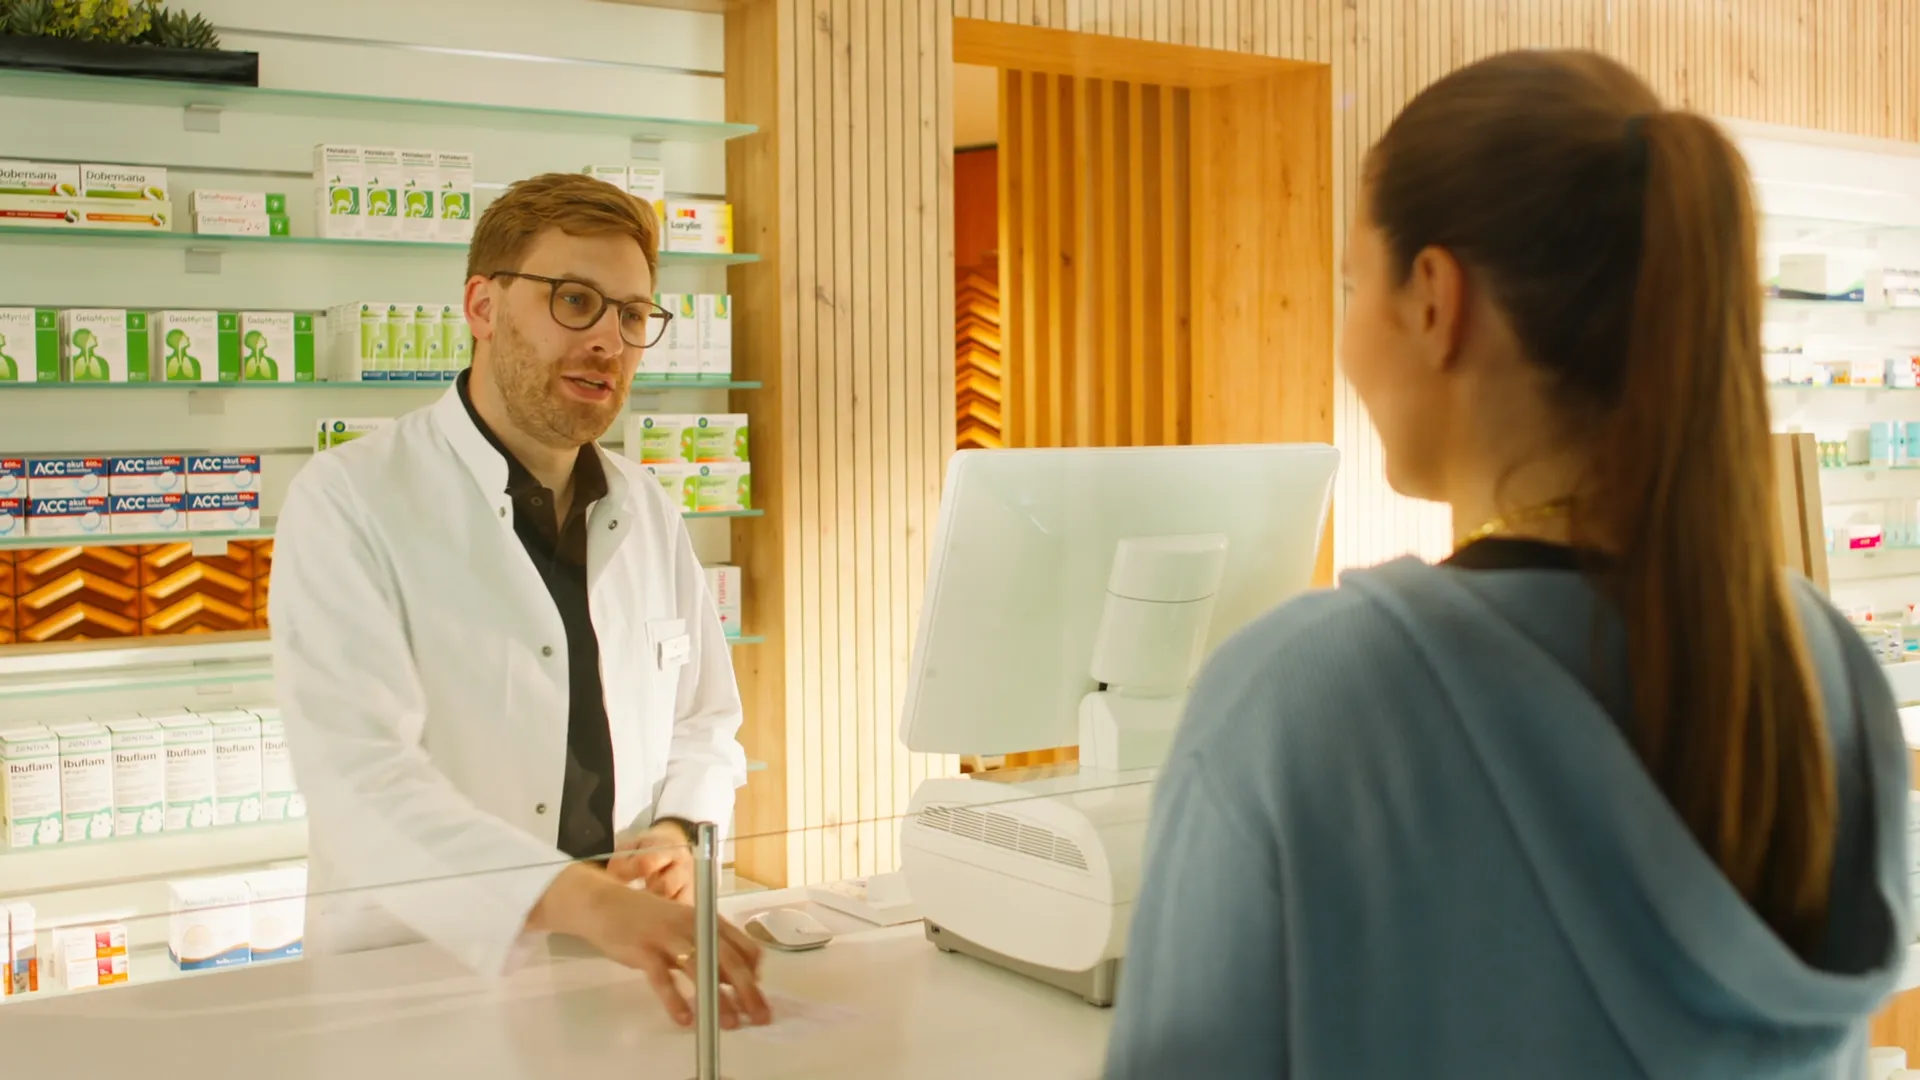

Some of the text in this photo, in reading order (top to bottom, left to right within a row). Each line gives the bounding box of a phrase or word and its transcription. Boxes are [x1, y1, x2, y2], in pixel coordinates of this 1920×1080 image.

[86, 170, 145, 183] Dobensana
[34, 461, 66, 476] ACC
[66, 460, 84, 469] akut
[115, 459, 144, 473] ACC
[146, 458, 163, 466] akut
[193, 458, 222, 471] ACC
[222, 457, 239, 465] akut
[37, 499, 68, 514] ACC
[68, 498, 86, 507] akut
[116, 497, 145, 510] ACC
[146, 495, 163, 504] akut
[192, 495, 221, 508] ACC
[221, 493, 238, 502] akut
[166, 748, 206, 758] Ibuflam
[216, 744, 255, 754] Ibuflam
[64, 758, 105, 769] Ibuflam
[116, 753, 157, 764] Ibuflam
[11, 763, 54, 774] Ibuflam
